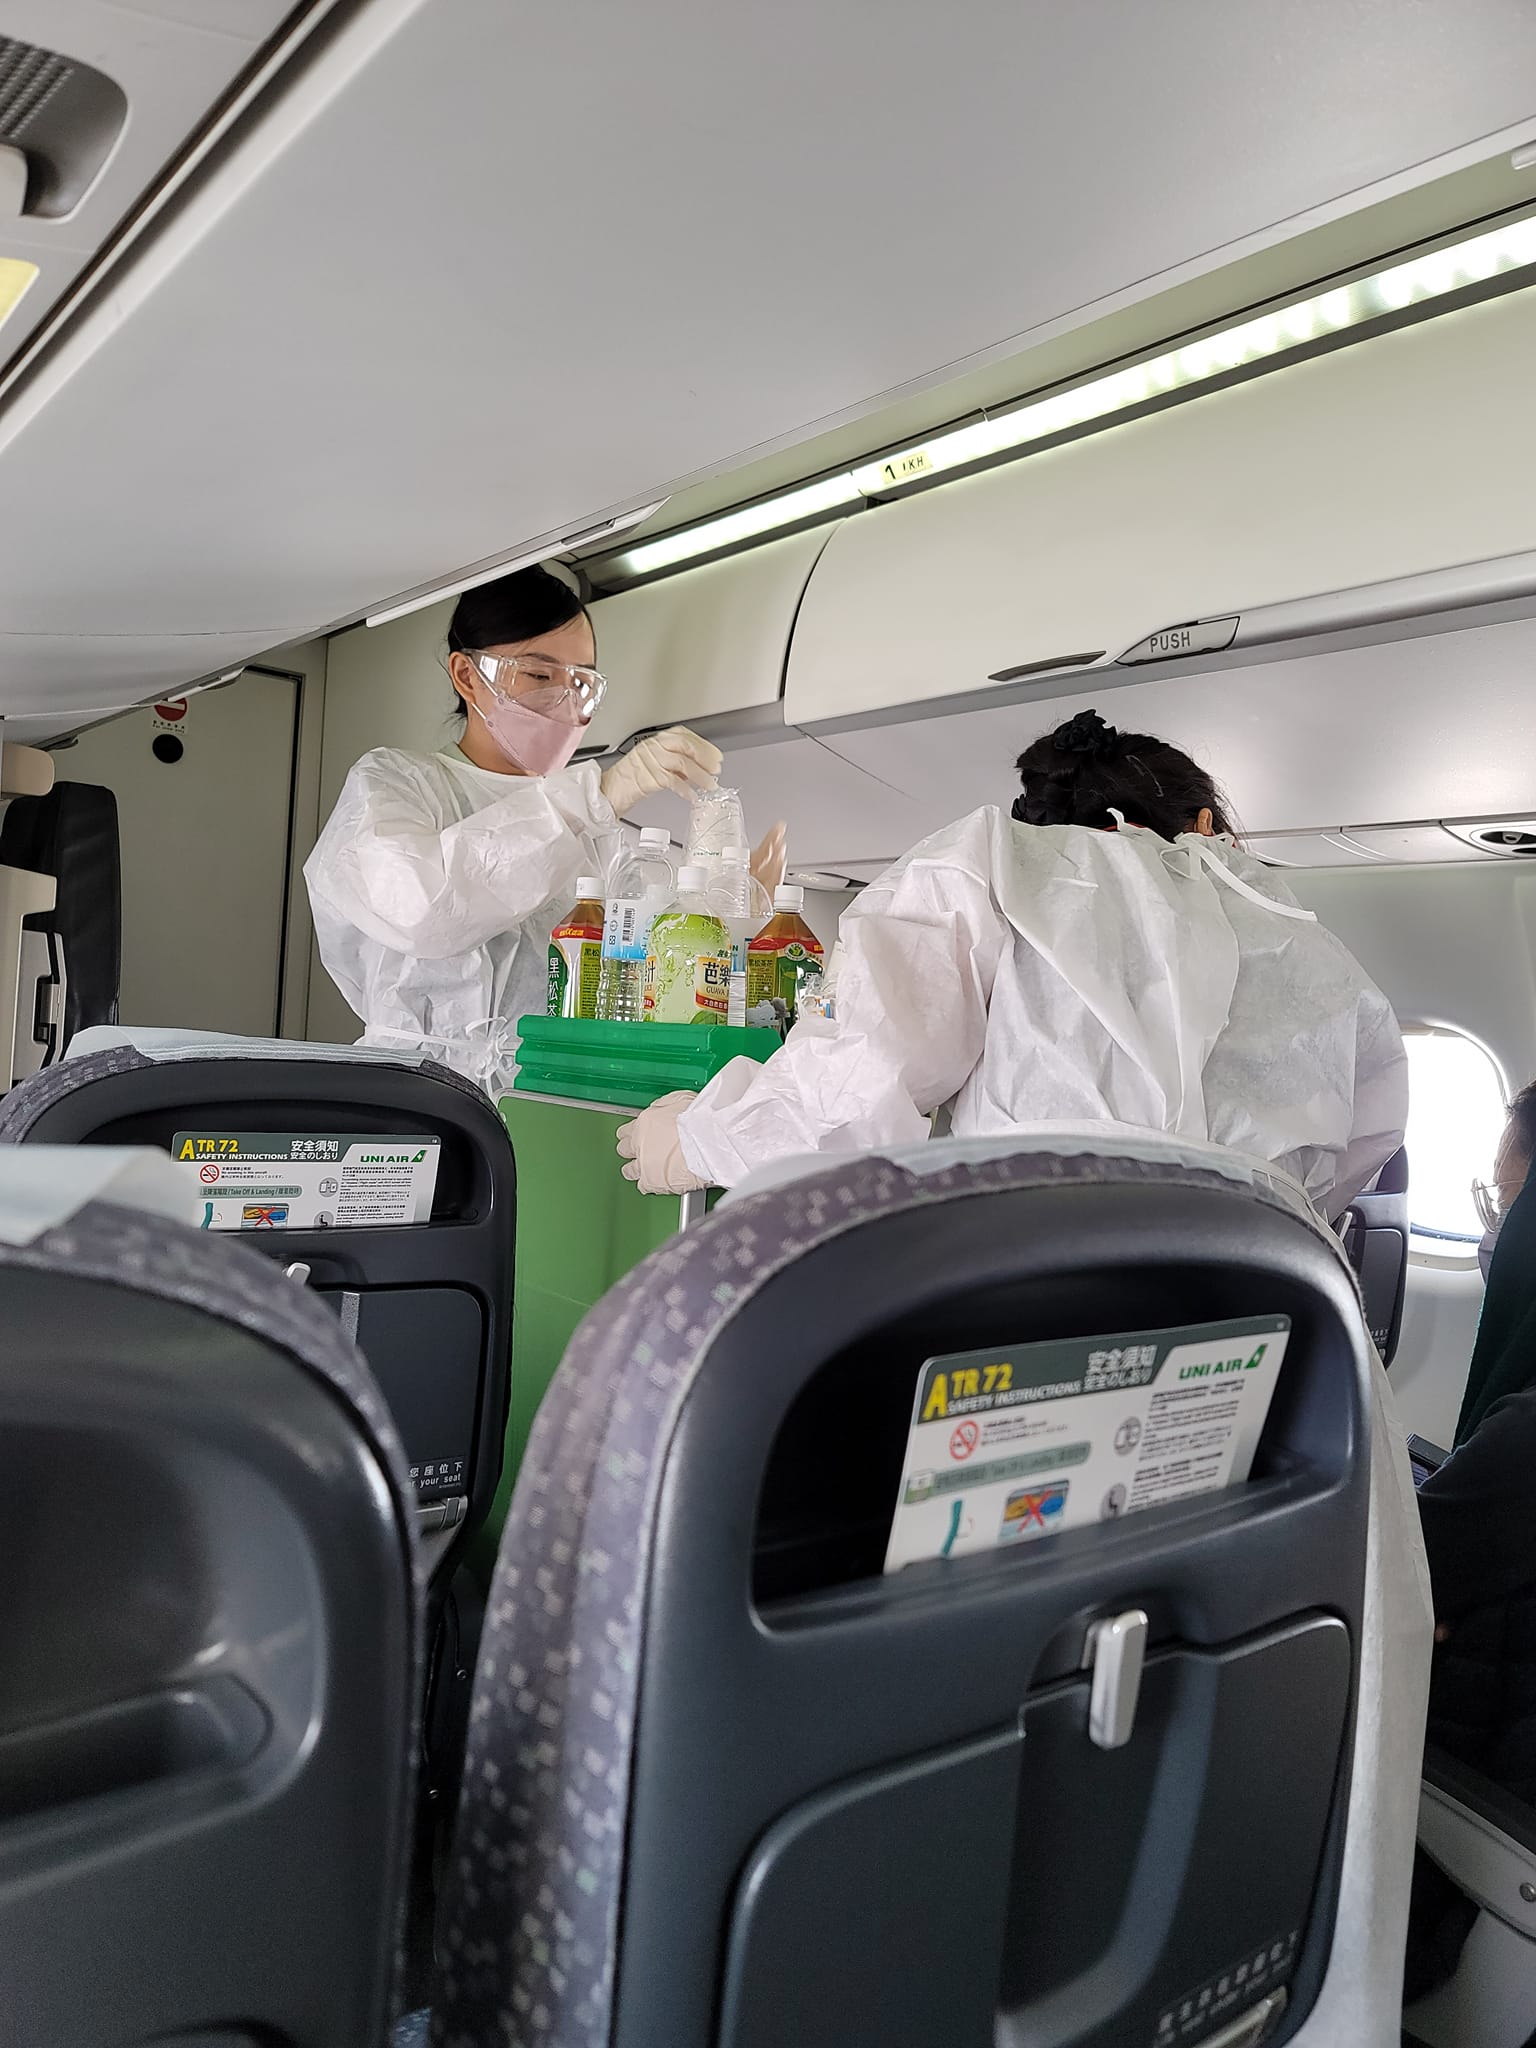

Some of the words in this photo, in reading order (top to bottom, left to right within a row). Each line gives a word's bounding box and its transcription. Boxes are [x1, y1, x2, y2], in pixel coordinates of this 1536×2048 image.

[1150, 631, 1190, 653] PUSH
[706, 985, 726, 996] GUAVA
[219, 1139, 239, 1153] 72
[291, 1140, 339, 1152] 安全須知
[290, 1151, 338, 1160] 安全のしおり
[360, 1155, 385, 1163] UNI
[386, 1155, 410, 1163] AIR
[1087, 1344, 1158, 1375] 安全須知
[983, 1363, 1013, 1391] 72
[1178, 1363, 1212, 1381] UNI
[1212, 1357, 1244, 1375] AIR
[947, 1393, 994, 1415] SAFETY
[993, 1379, 1082, 1407] INSTRUCTIONS
[420, 1477, 440, 1489] your
[443, 1473, 461, 1483] seat
